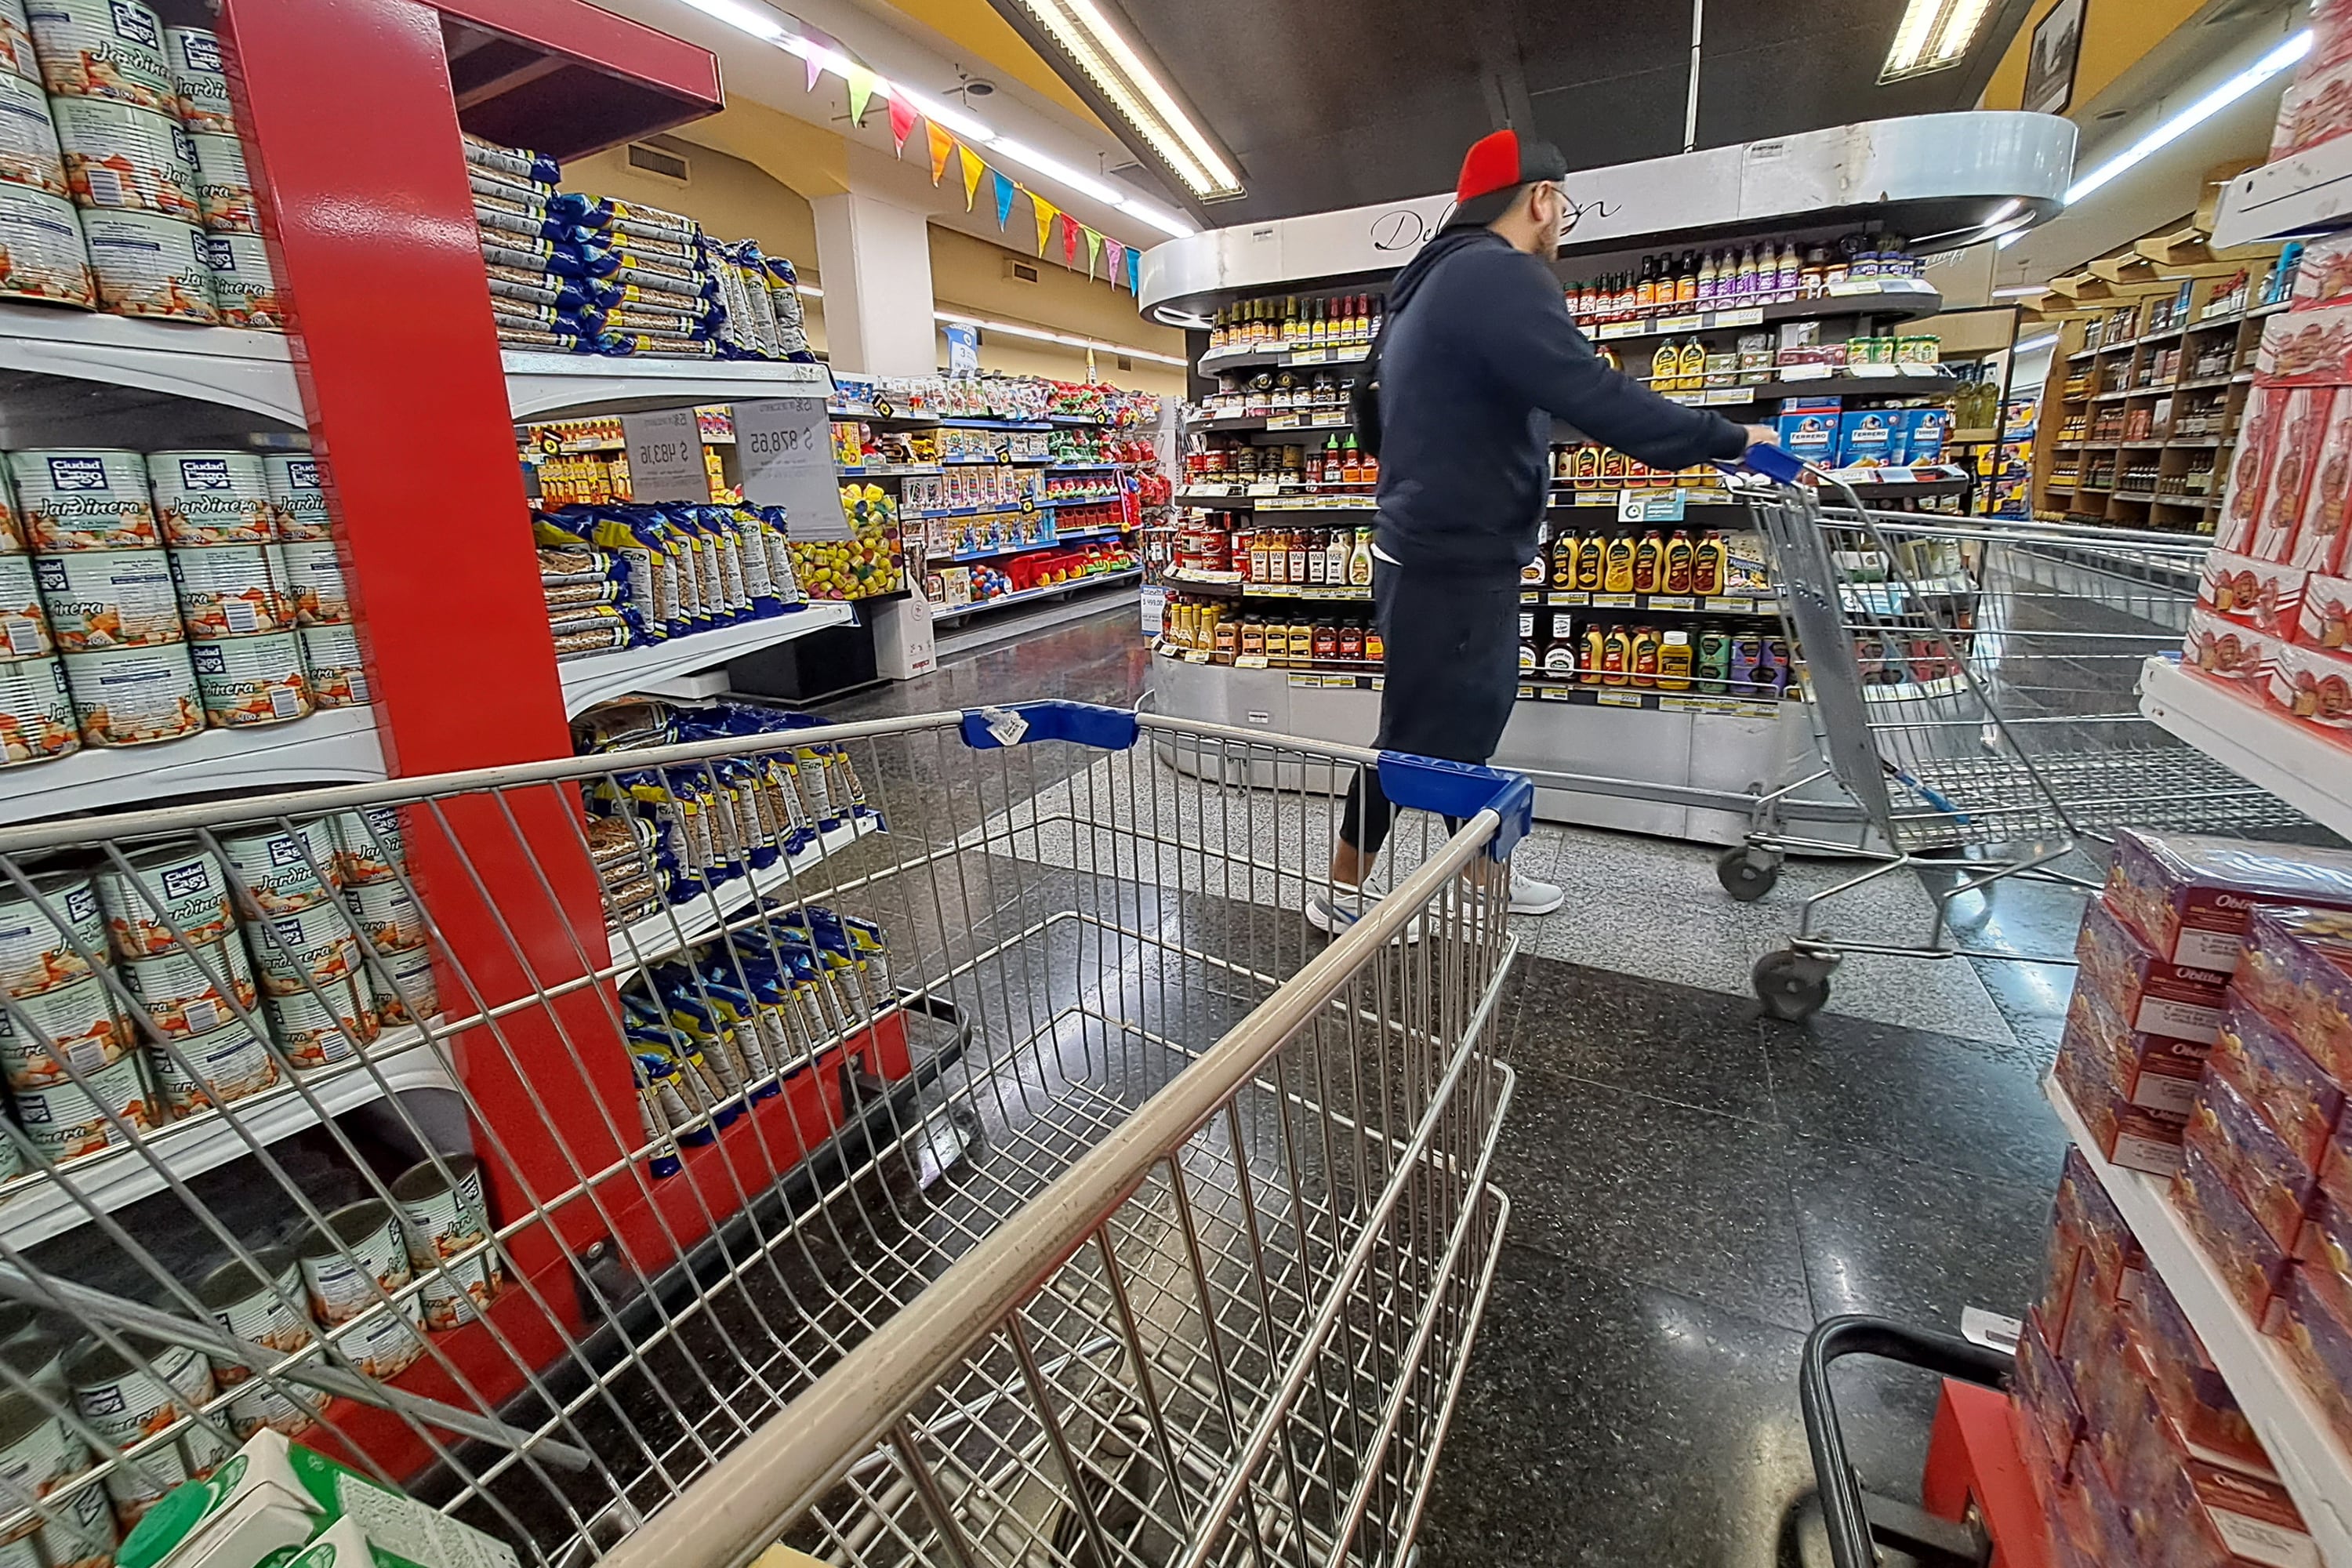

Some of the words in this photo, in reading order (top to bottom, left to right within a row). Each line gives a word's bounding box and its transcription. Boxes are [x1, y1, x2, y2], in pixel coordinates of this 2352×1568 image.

[52, 460, 100, 470] Ciudad
[182, 461, 225, 470] Ciudad
[38, 495, 140, 517] Jardinera
[170, 494, 257, 516] Jardinera
[165, 864, 203, 881] Ciudad
